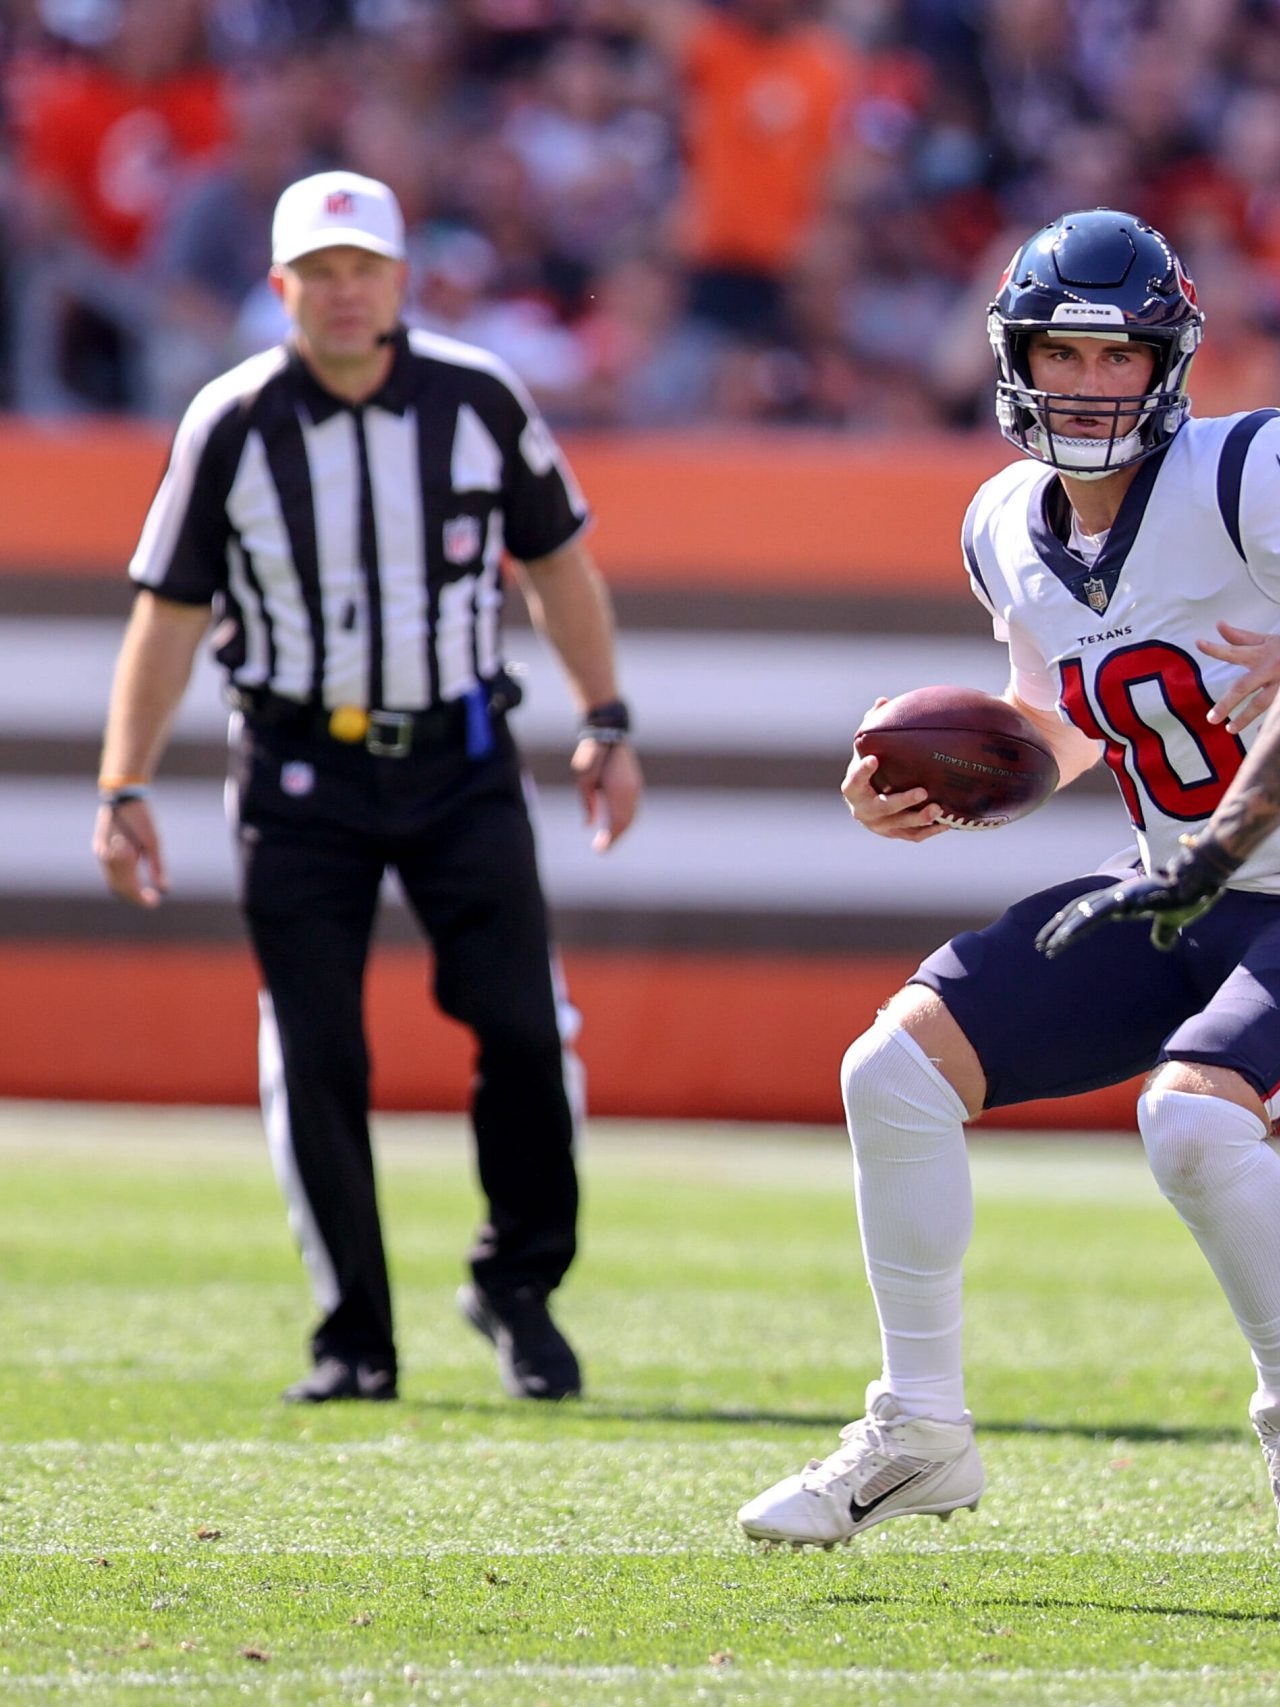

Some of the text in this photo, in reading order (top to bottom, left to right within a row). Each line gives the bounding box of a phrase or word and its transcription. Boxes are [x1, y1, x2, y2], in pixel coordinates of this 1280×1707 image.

[1064, 308, 1111, 316] TEXANS
[1077, 625, 1133, 646] TEXANS
[1059, 639, 1248, 831] 10
[932, 752, 969, 768] LEAGUE
